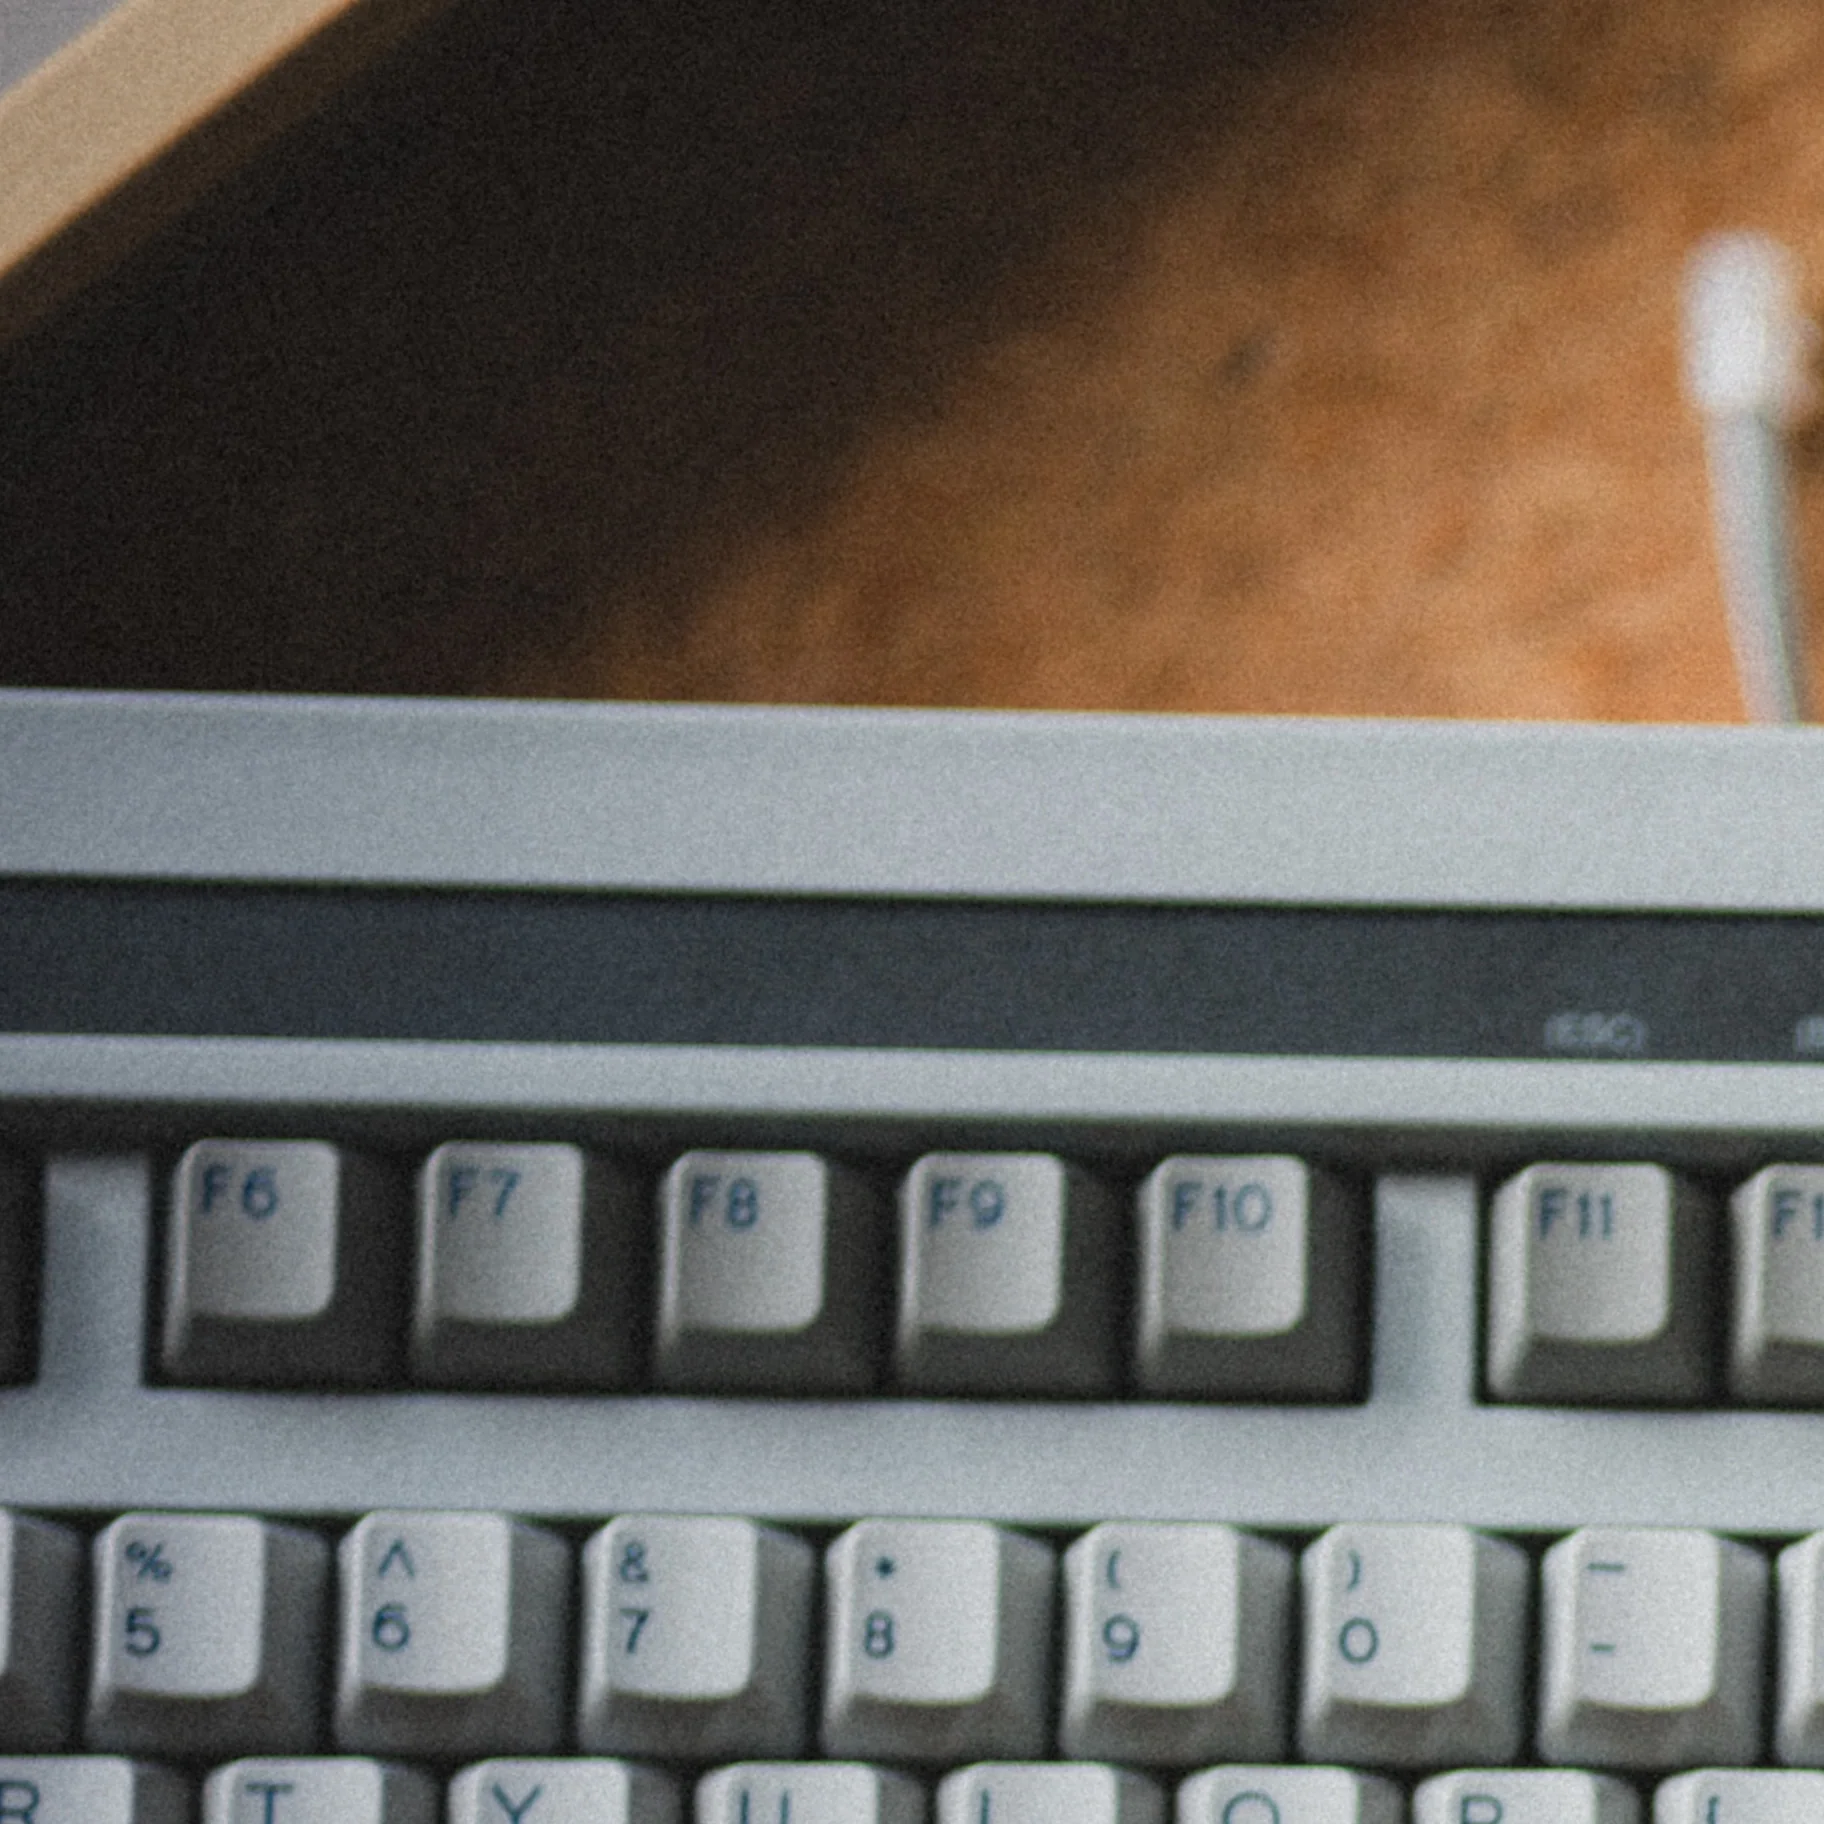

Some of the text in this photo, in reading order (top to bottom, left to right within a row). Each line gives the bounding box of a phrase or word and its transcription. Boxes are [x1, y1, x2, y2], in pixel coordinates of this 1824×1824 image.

[199, 1162, 280, 1221] F6
[448, 1164, 522, 1219] F7
[686, 1173, 760, 1231] F8
[925, 1174, 1005, 1234] F9
[1166, 1178, 1275, 1236] F10
[1534, 1185, 1612, 1243] F11
[122, 1539, 174, 1583] %
[616, 1539, 651, 1586] &
[1103, 1548, 1122, 1592] (
[1344, 1549, 1364, 1593] )
[122, 1604, 163, 1660] 5
[369, 1602, 411, 1653] 6
[619, 1606, 651, 1656] 7
[861, 1610, 896, 1661] 8
[1100, 1613, 1141, 1666] 9
